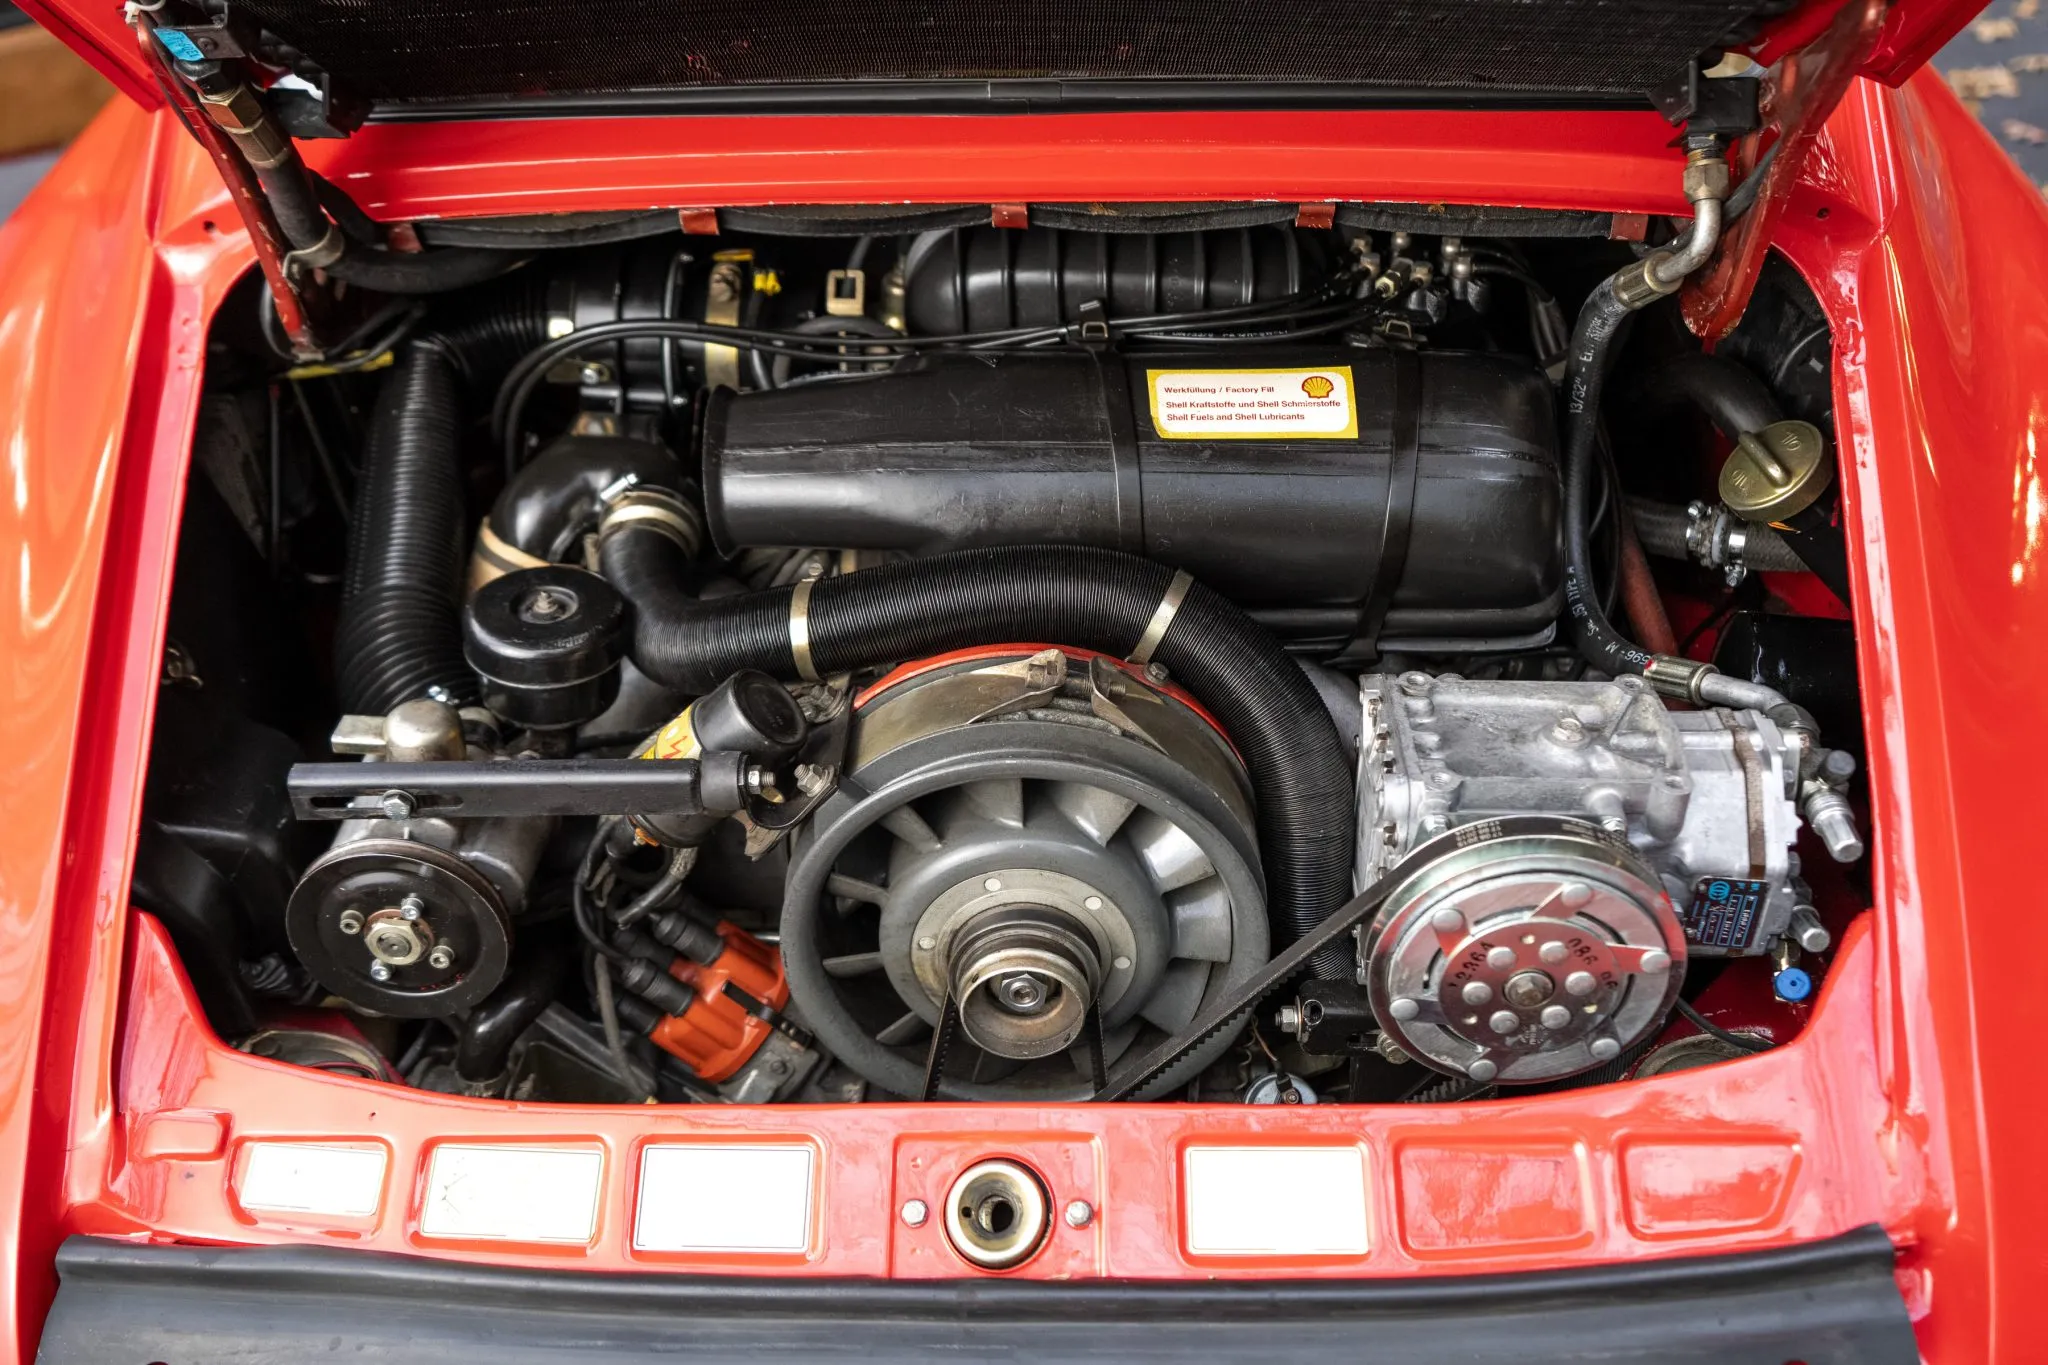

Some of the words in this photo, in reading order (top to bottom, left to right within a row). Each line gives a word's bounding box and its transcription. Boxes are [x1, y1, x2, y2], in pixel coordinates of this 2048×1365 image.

[1164, 386, 1216, 394] Werkfüllung
[1225, 386, 1258, 394] Factory
[1257, 400, 1279, 408] Shell
[1281, 400, 1341, 408] Schmierstoffe
[1167, 413, 1189, 421] Shell
[1190, 413, 1214, 421] Fuels
[1216, 413, 1233, 421] and
[1234, 413, 1257, 421] Shell
